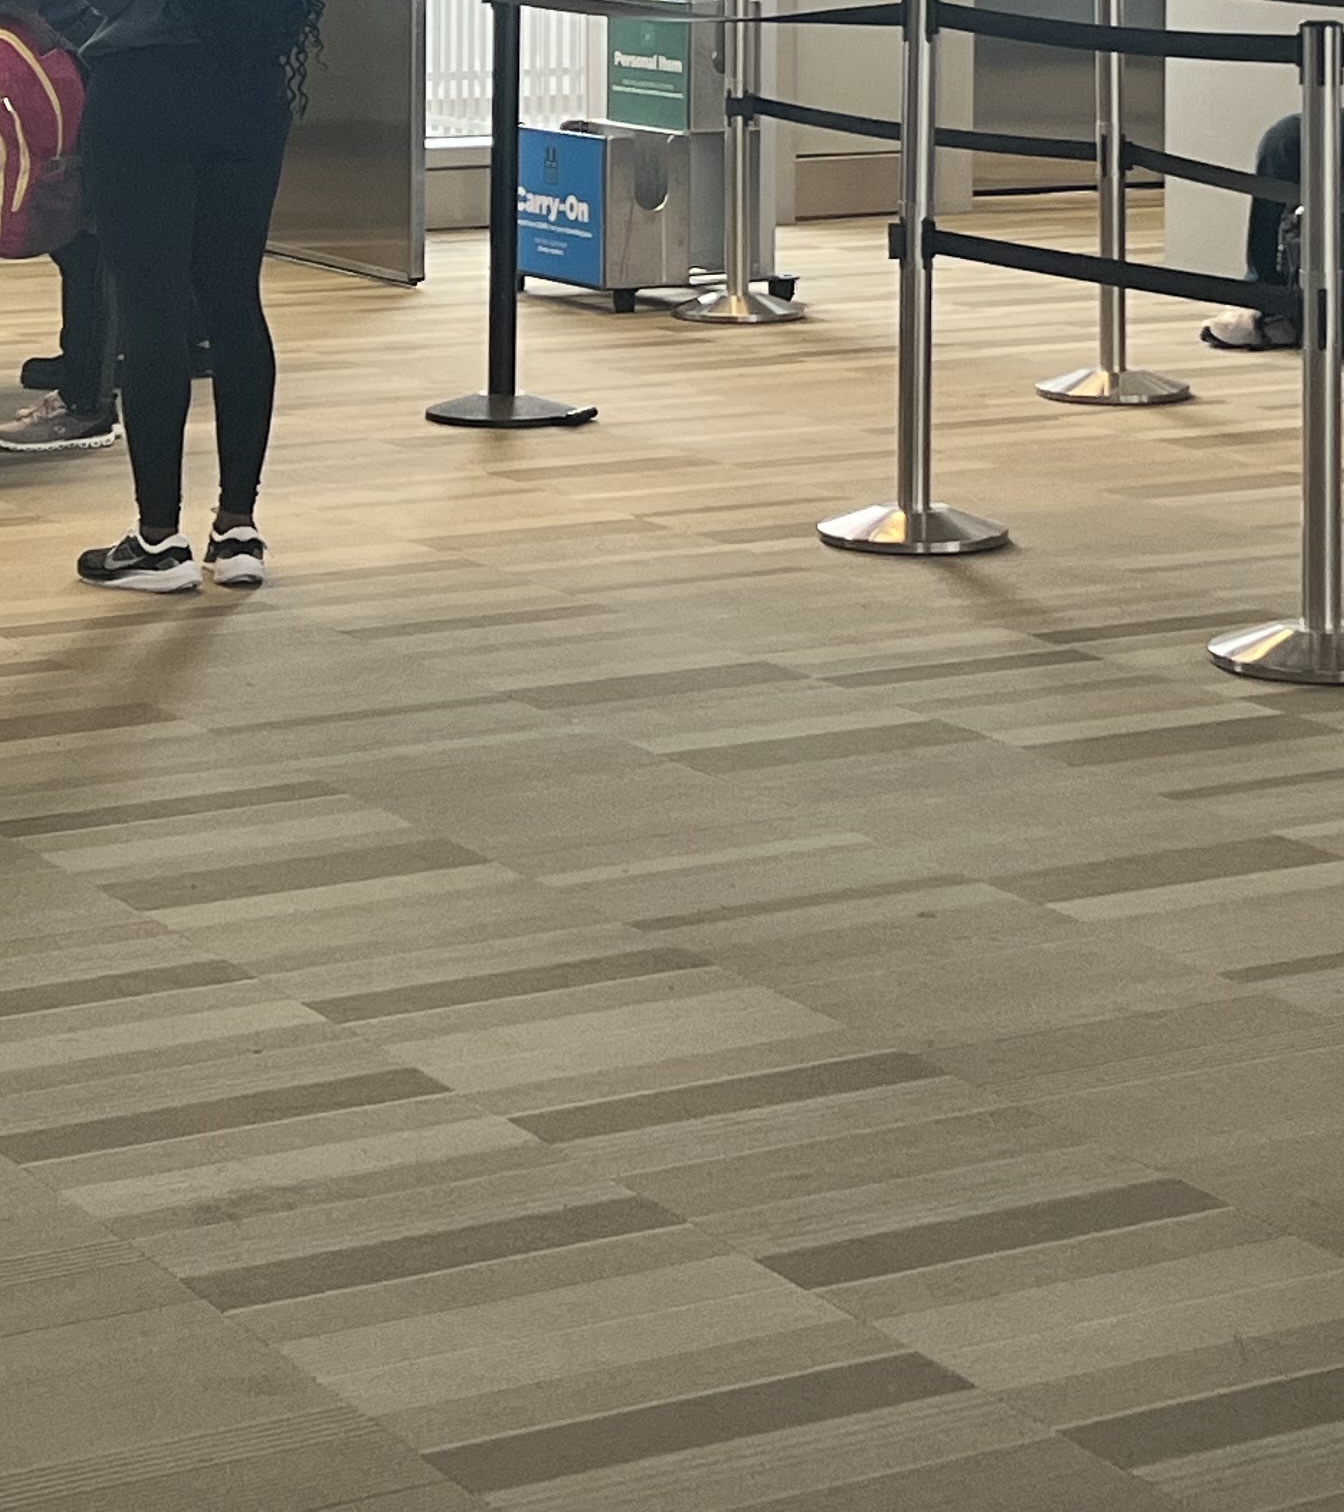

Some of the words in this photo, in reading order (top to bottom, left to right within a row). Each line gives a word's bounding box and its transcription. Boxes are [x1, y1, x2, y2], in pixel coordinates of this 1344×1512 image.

[613, 50, 656, 72] Personal
[658, 54, 684, 73] Item
[517, 186, 590, 224] Carry-On
